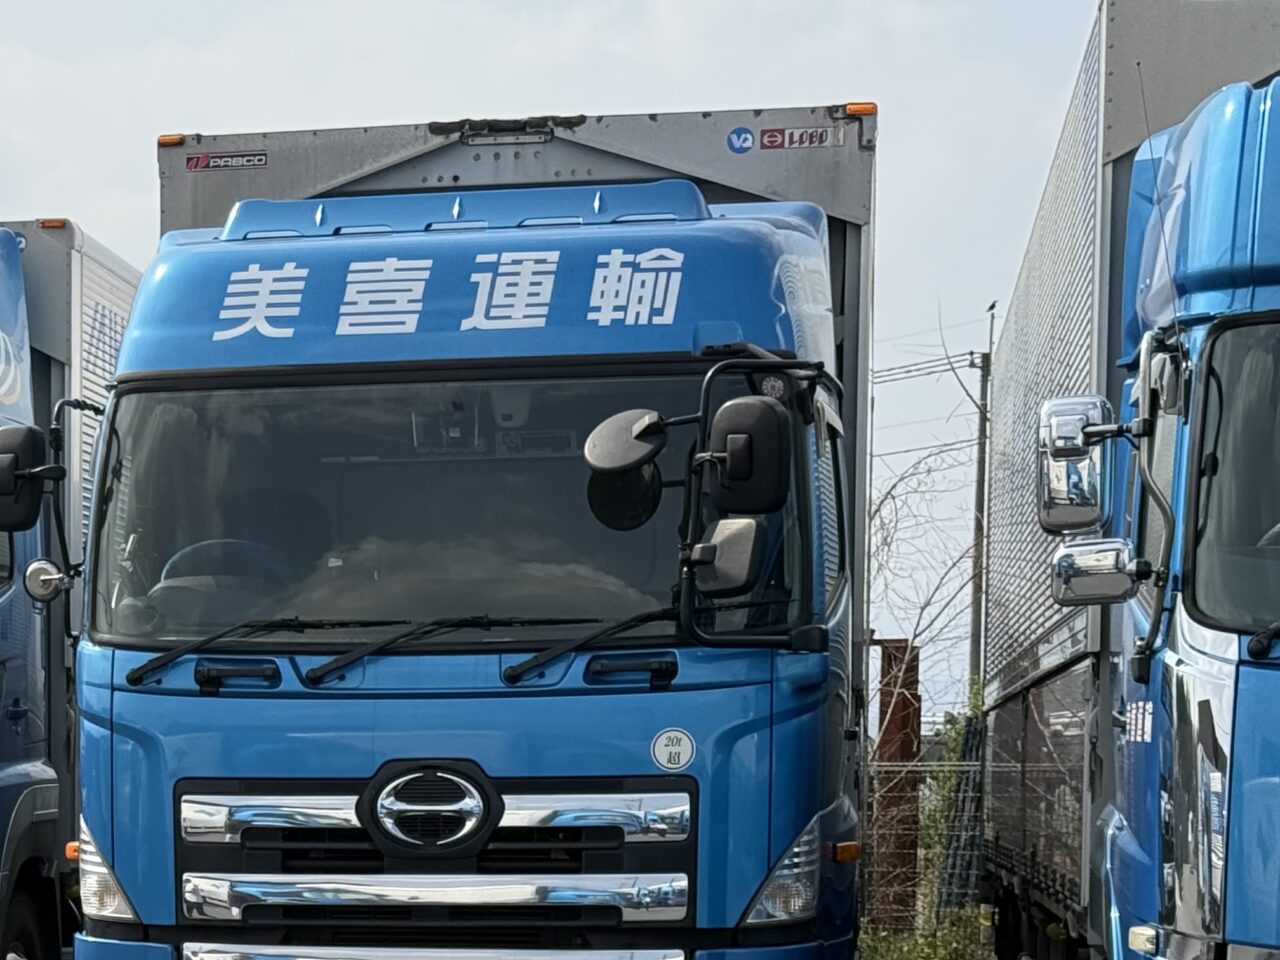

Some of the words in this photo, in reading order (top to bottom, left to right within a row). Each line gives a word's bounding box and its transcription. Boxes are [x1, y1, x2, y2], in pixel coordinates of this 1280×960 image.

[209, 155, 267, 168] PABCO
[212, 247, 686, 342] 美喜運輸
[663, 735, 683, 748] 20t
